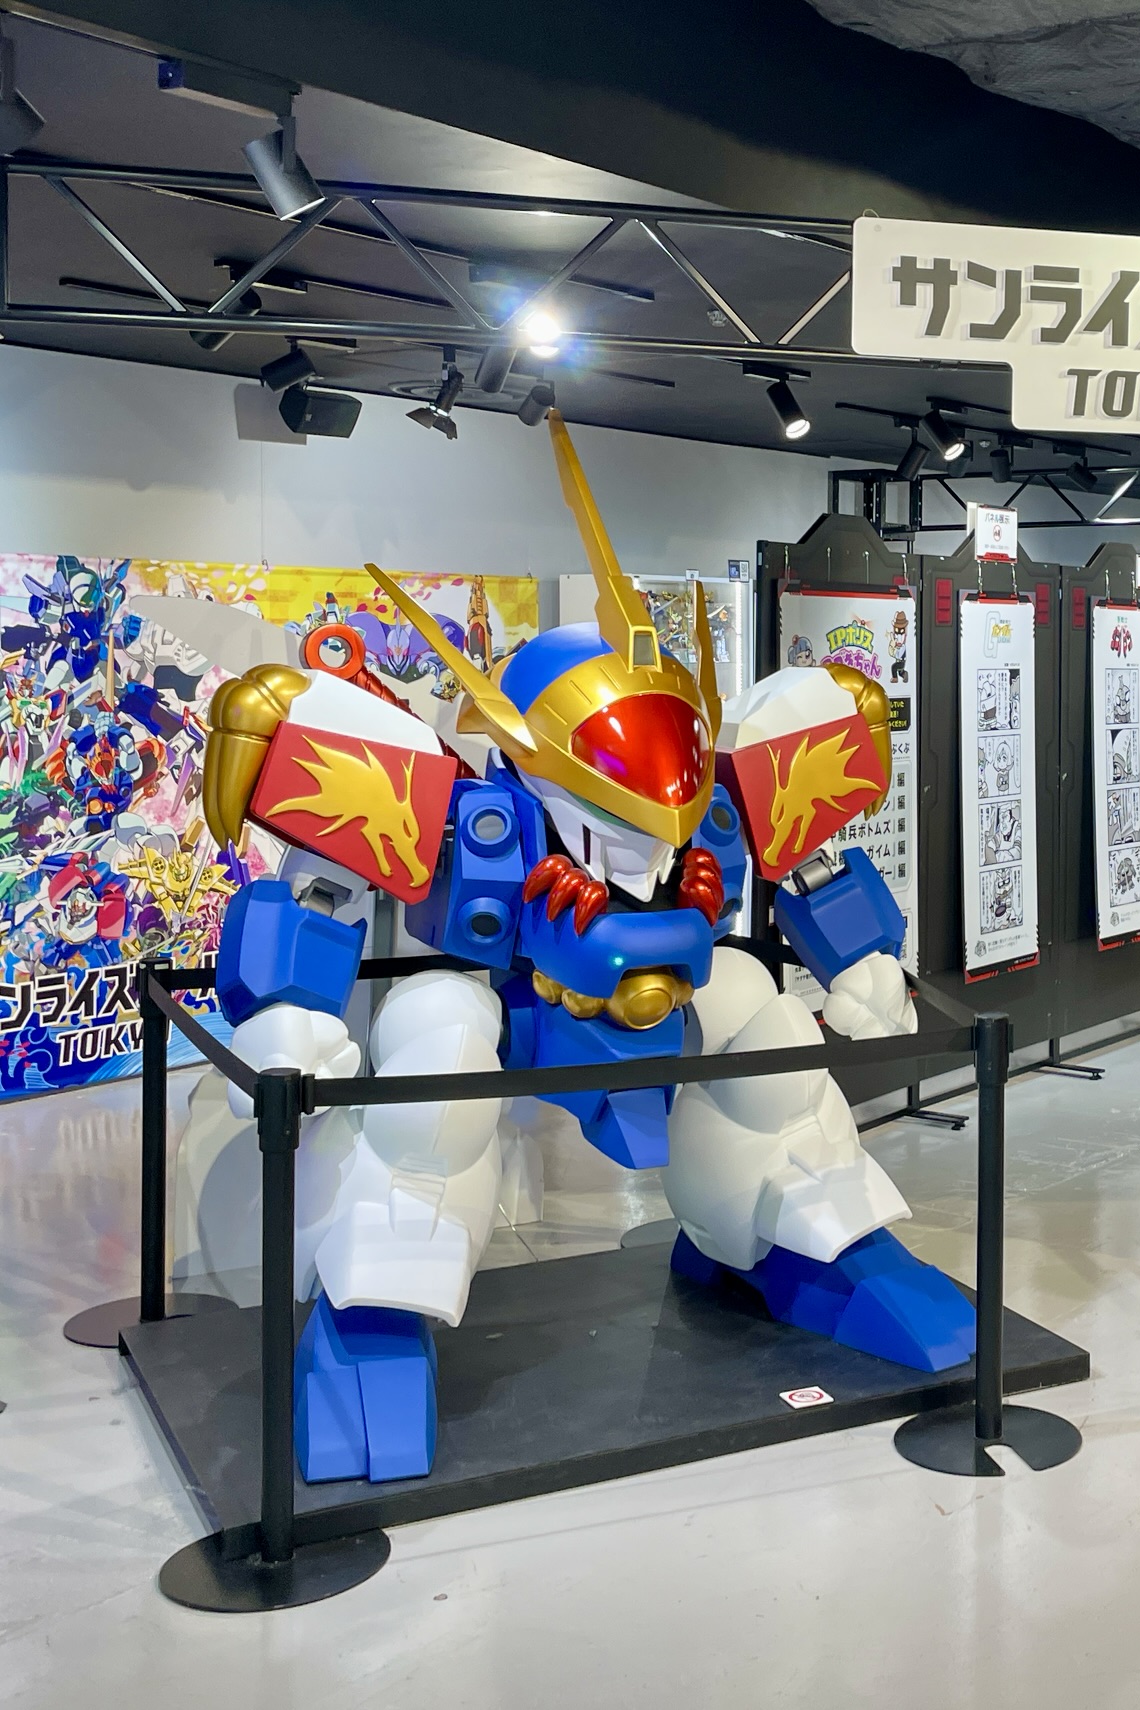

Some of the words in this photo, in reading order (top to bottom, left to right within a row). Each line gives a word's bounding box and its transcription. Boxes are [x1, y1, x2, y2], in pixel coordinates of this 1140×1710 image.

[826, 620, 874, 654] IPポリス
[57, 1019, 143, 1067] TOKY
